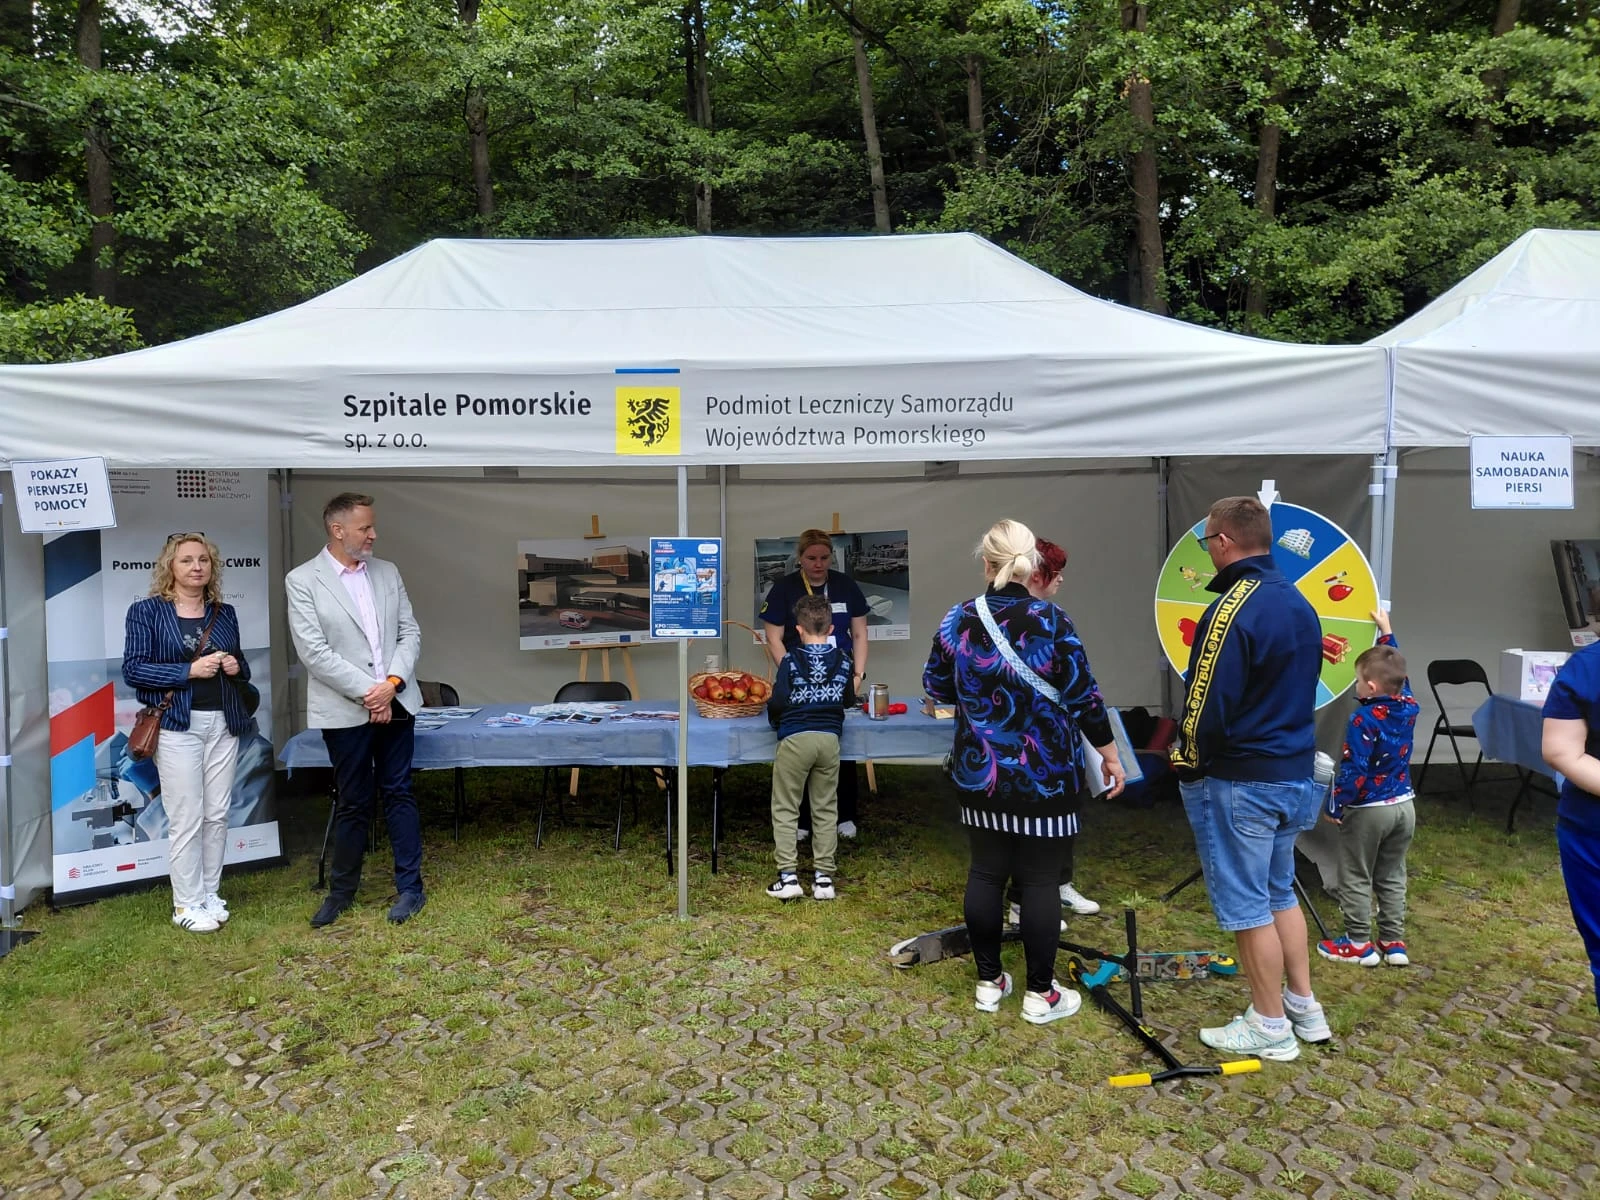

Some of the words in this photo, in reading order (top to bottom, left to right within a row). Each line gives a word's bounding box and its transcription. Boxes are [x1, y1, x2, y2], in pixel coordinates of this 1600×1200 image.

[344, 392, 447, 423] Szpitale
[456, 390, 592, 416] Pomorskie
[706, 395, 792, 415] Podmiot
[799, 393, 894, 418] Leczniczy
[901, 392, 1014, 417] Samorządu
[344, 433, 372, 452] sp.
[377, 434, 387, 447] z
[393, 433, 427, 448] o.o.
[706, 426, 845, 451] Województwa
[853, 424, 986, 447] Pomorskiego
[1500, 451, 1545, 461] NAUKA
[30, 467, 78, 480] POKAZY
[1476, 467, 1569, 477] SAMOBADANIA
[27, 482, 88, 496] PIERWSZEJ
[1505, 482, 1542, 492] PIERSI
[34, 498, 87, 511] POMOCY
[112, 560, 157, 571] Pomor
